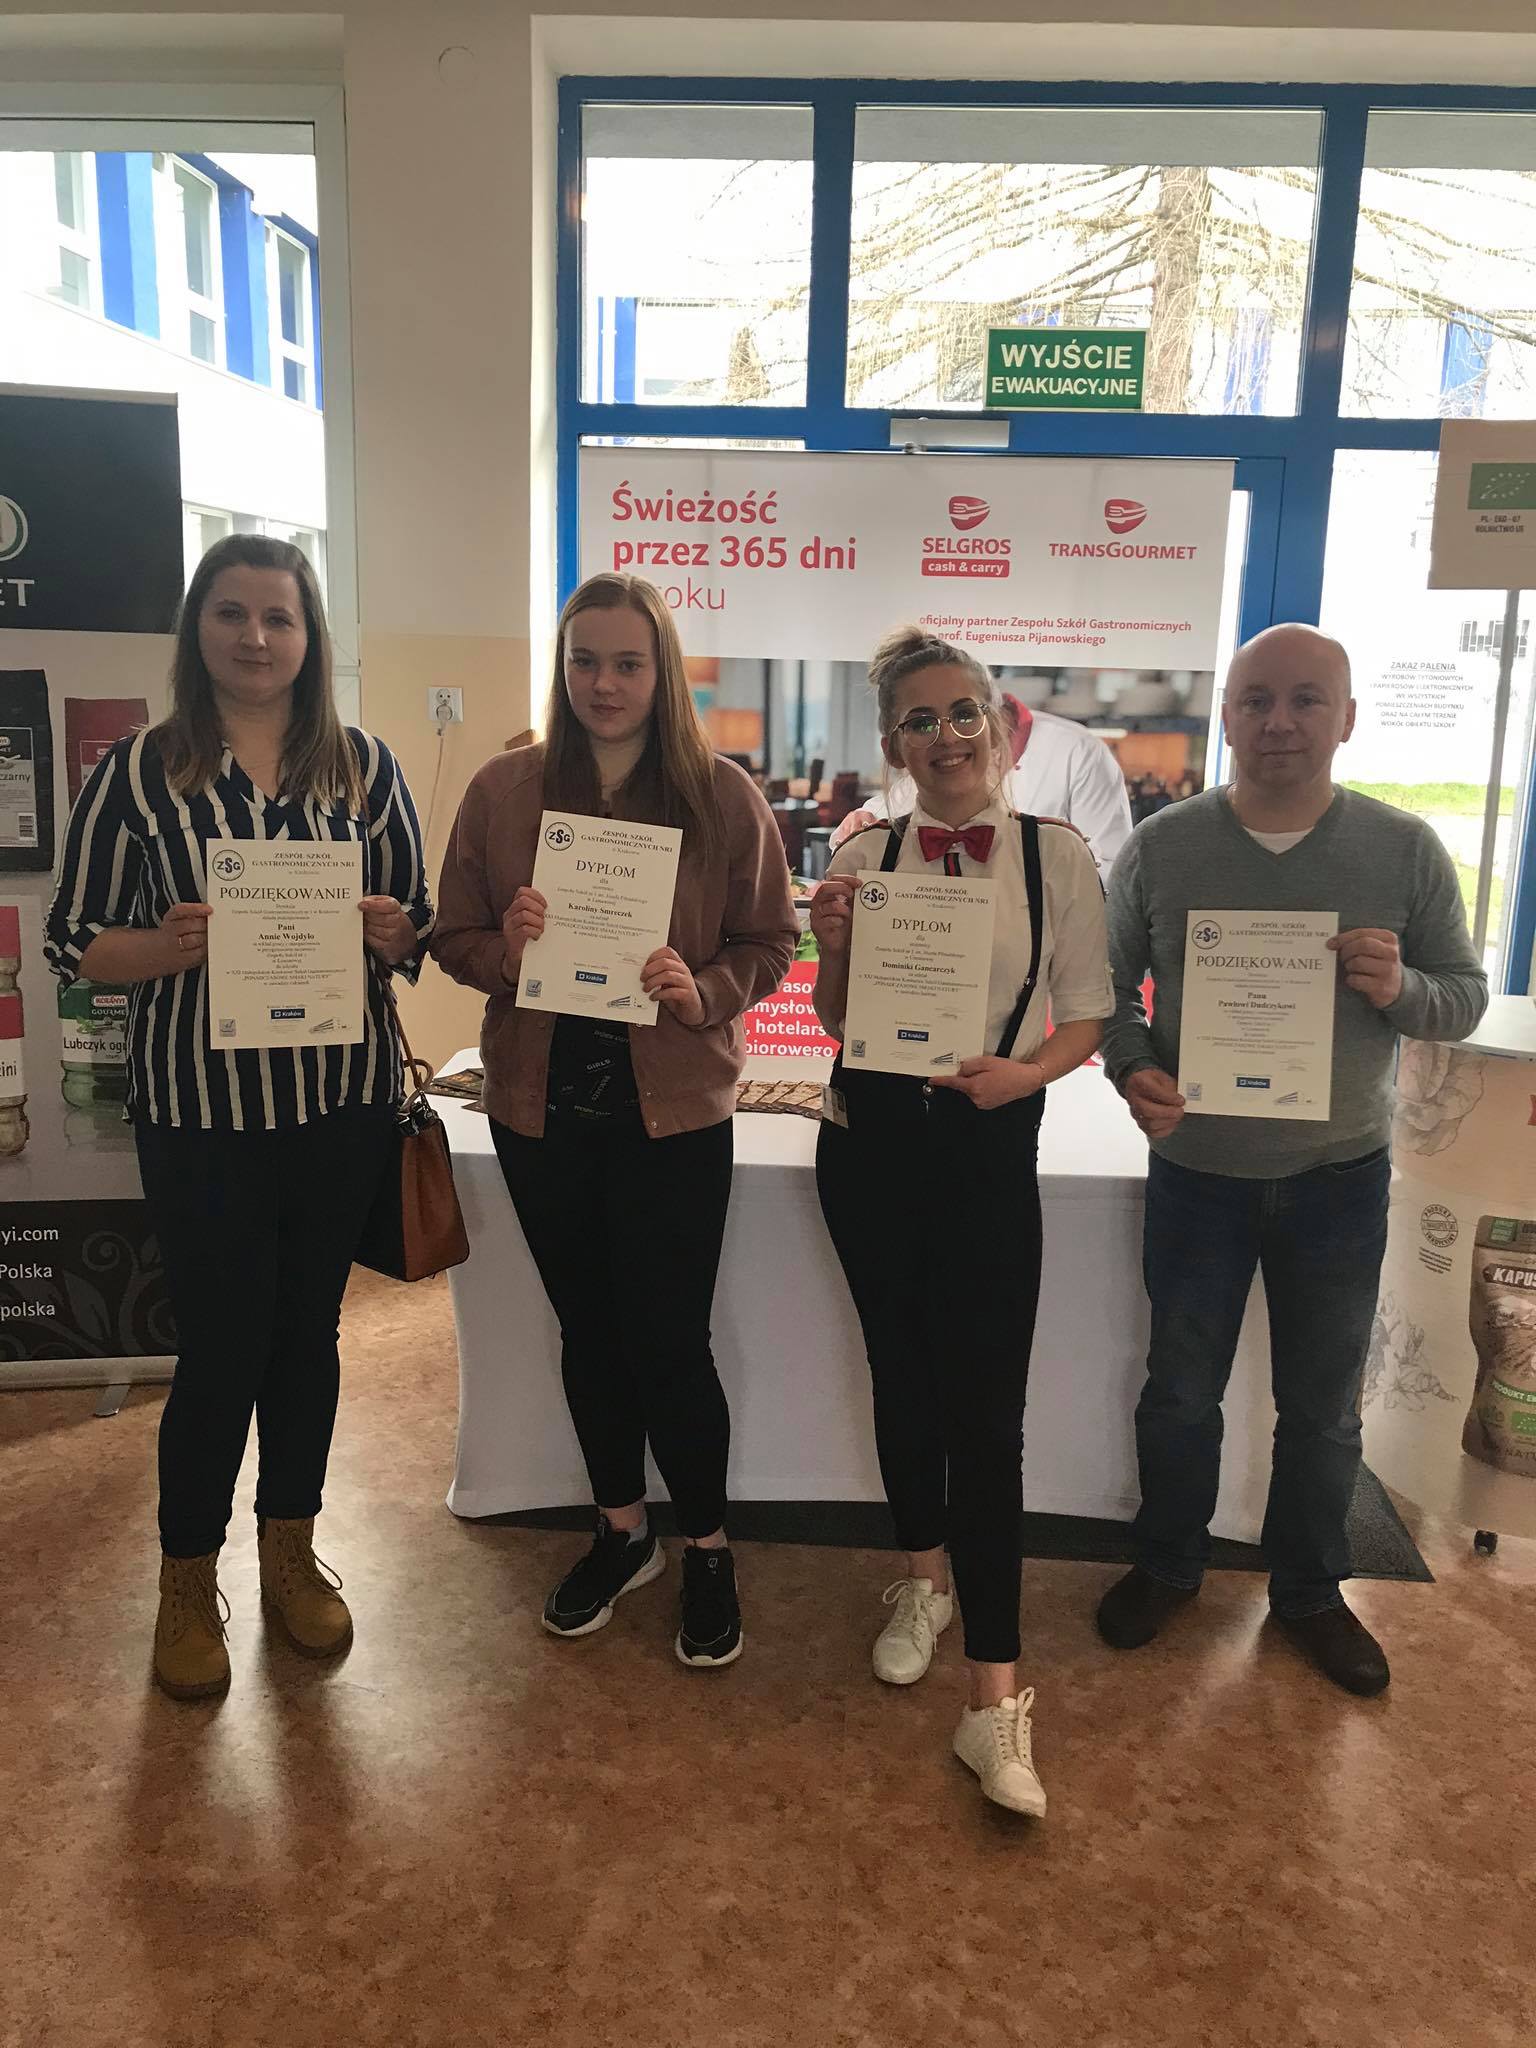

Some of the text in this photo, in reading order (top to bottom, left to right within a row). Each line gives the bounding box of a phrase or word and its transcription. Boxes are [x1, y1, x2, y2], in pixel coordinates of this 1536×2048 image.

[1001, 339, 1132, 370] WYJŚCIE
[991, 376, 1137, 395] EWAKUACYJNE
[612, 480, 778, 524] Świeżość
[613, 535, 856, 571] przez 365 dni
[922, 537, 1011, 555] SELGROS
[1049, 542, 1197, 560] TRANSGOURMET
[928, 561, 1003, 575] cash & carry
[658, 577, 726, 609] oku
[919, 615, 1192, 633] oficjalny partner Zespołu Szkół Gastronomicznych
[965, 631, 1026, 644] Eugeniusza
[1028, 633, 1106, 646] Pijanowskiego
[1420, 662, 1456, 671] PALENIA
[576, 860, 636, 879] DYPLOM
[220, 887, 350, 902] PODZIĘKOWANIE
[568, 903, 599, 914] Karoliny
[892, 918, 952, 933] DYPLOM
[1196, 955, 1323, 970] PODZIĘKOWANIE
[783, 982, 815, 993] aso
[63, 1037, 106, 1053] Lubczyk
[0, 1060, 17, 1077] ini
[0, 1263, 53, 1279] Polska
[0, 1301, 55, 1321] polska
